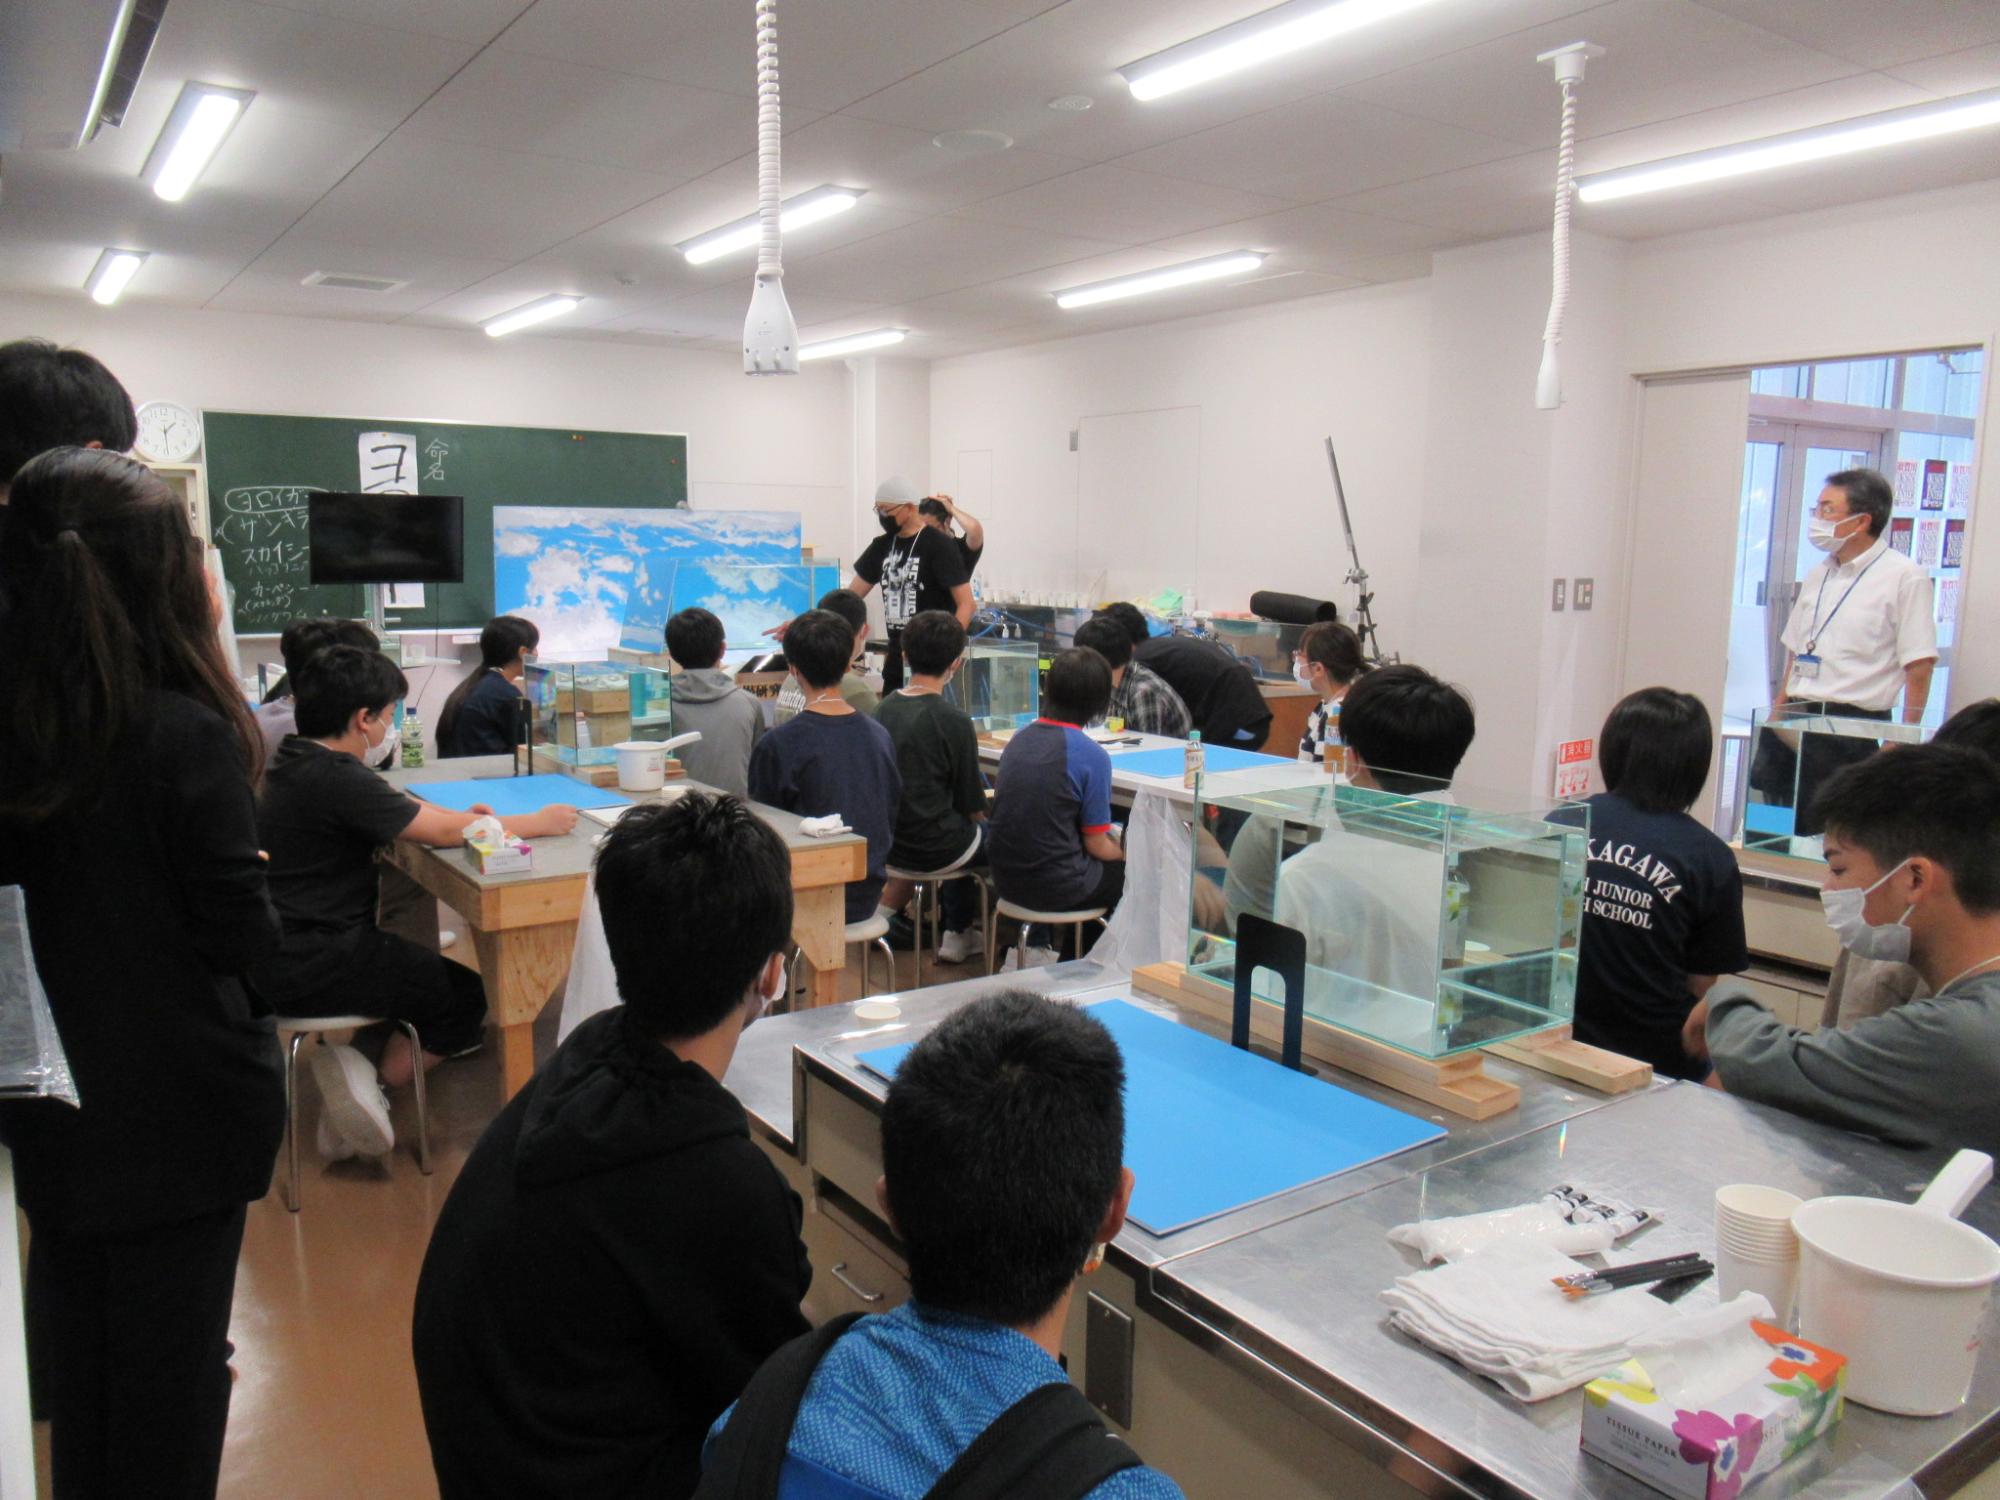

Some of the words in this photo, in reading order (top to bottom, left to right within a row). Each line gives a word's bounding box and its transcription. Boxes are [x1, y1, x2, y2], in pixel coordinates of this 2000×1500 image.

[423, 438, 449, 481] 命名
[237, 487, 309, 512] ヨロイガ
[1593, 879, 1653, 910] JUNIOR
[1592, 899, 1653, 930] SCHOOL
[1606, 1416, 1640, 1439] TISSUE
[1644, 1436, 1677, 1458] PAPER
